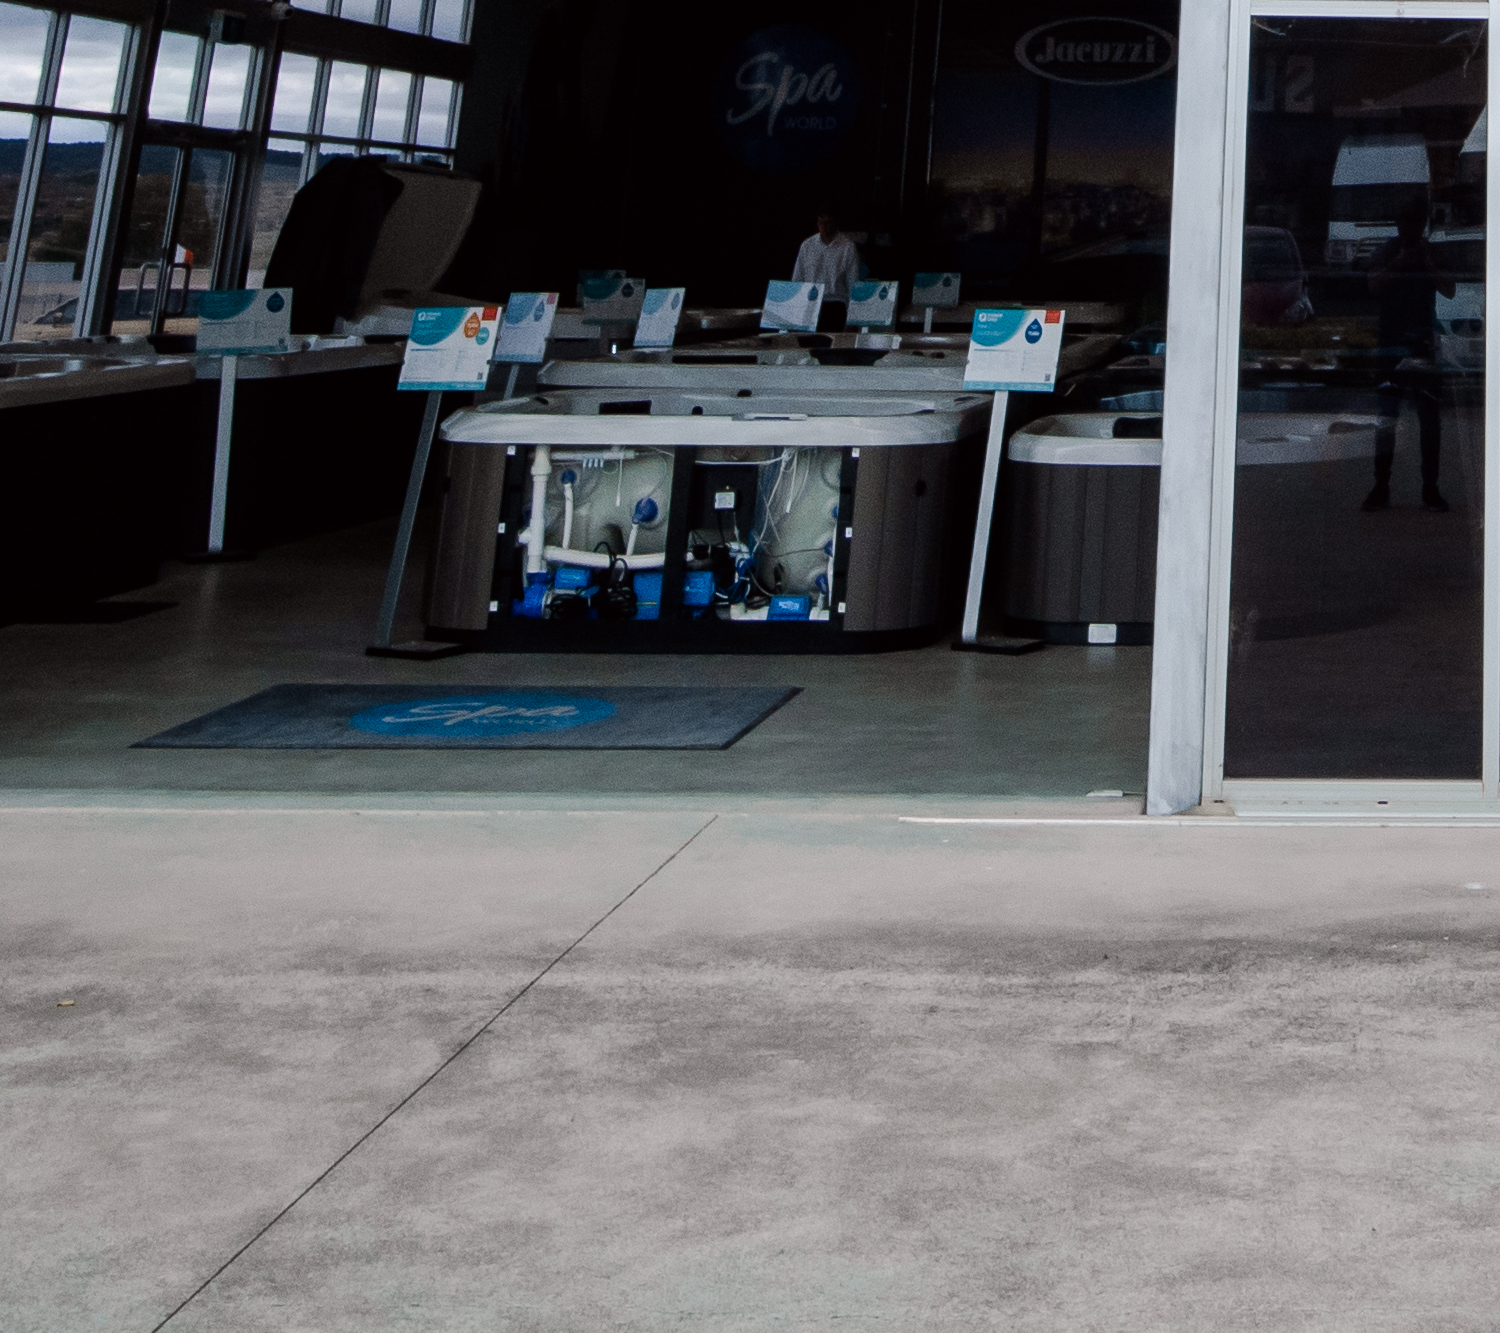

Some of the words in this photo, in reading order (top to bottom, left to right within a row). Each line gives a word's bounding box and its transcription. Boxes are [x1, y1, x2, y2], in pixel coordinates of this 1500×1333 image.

[1035, 35, 1156, 64] Jacuzzi
[727, 52, 843, 135] Spa
[784, 116, 837, 130] WORLD
